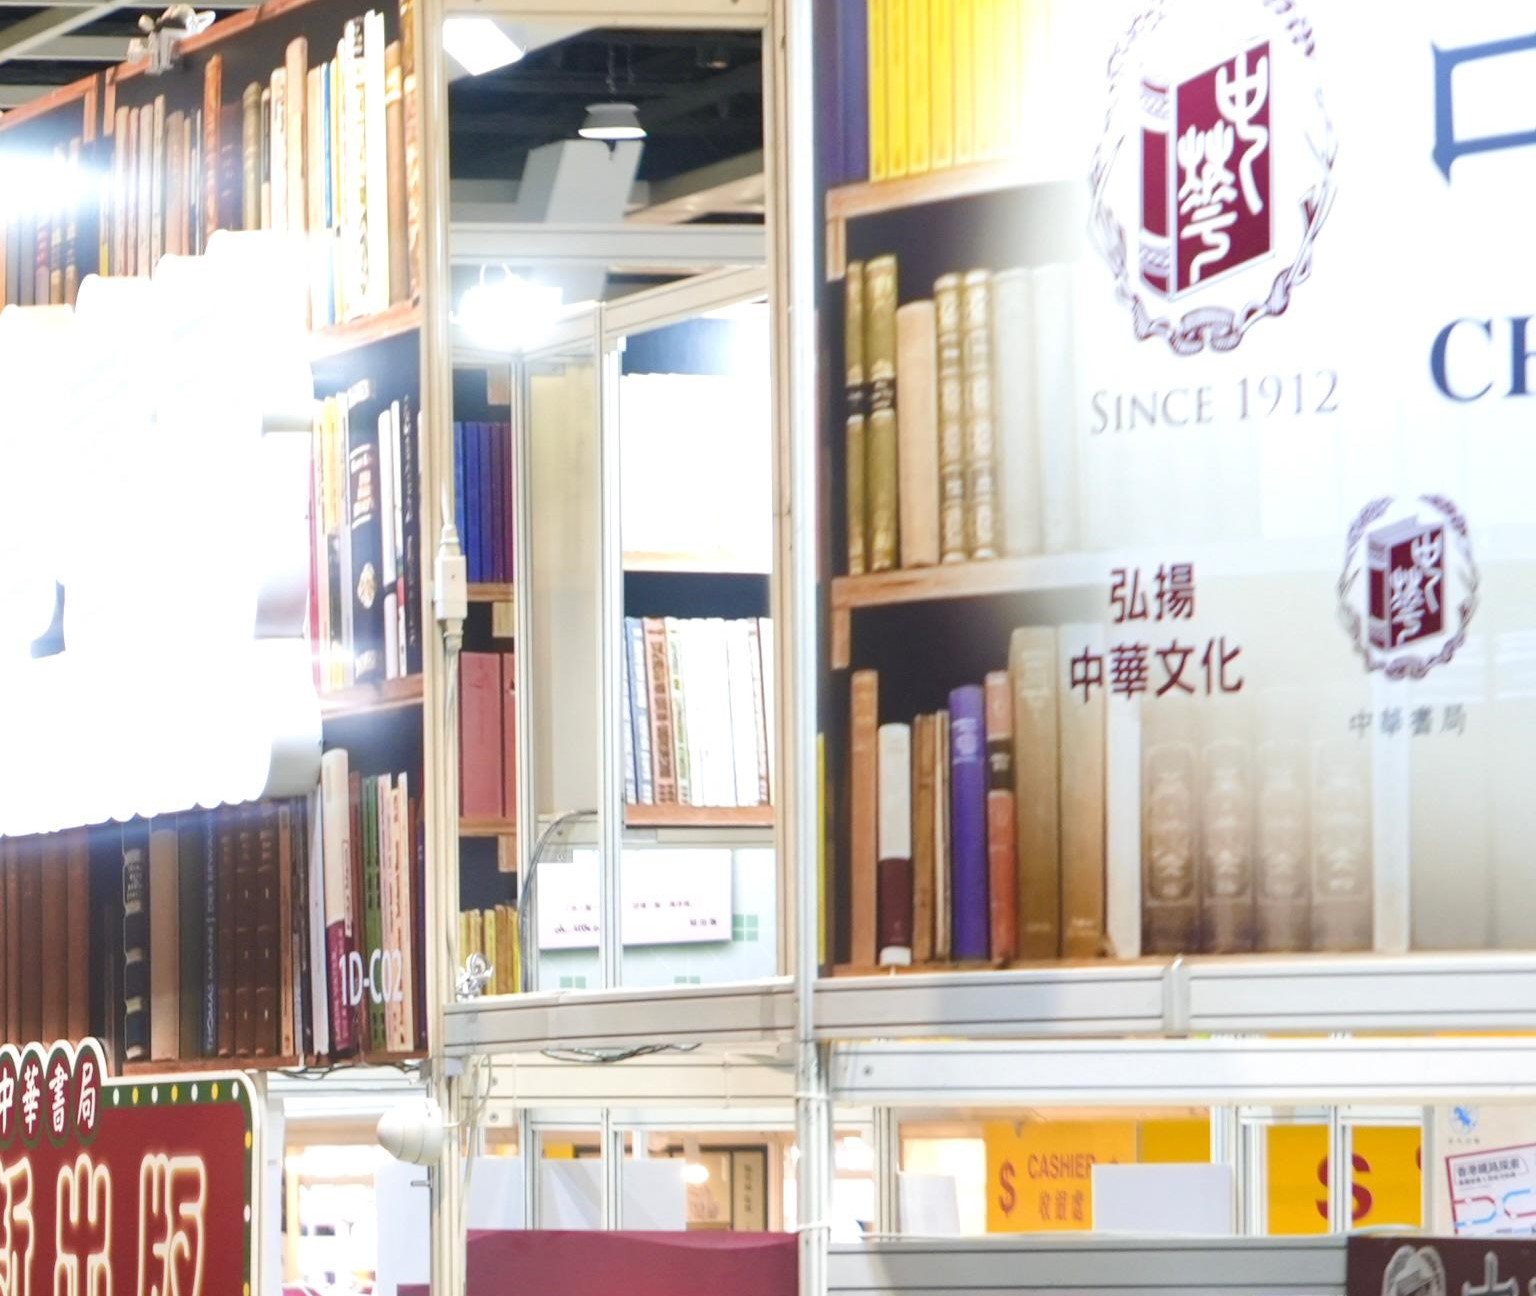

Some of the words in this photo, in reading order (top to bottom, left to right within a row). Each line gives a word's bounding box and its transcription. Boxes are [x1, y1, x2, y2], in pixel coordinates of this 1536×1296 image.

[1091, 384, 1214, 437] SINCE
[1236, 368, 1339, 422] 1912
[1108, 561, 1196, 626] 弘揚
[1069, 635, 1245, 705] 中華文化
[1348, 702, 1467, 739] 中華書局
[338, 948, 404, 1008] 1D-C02
